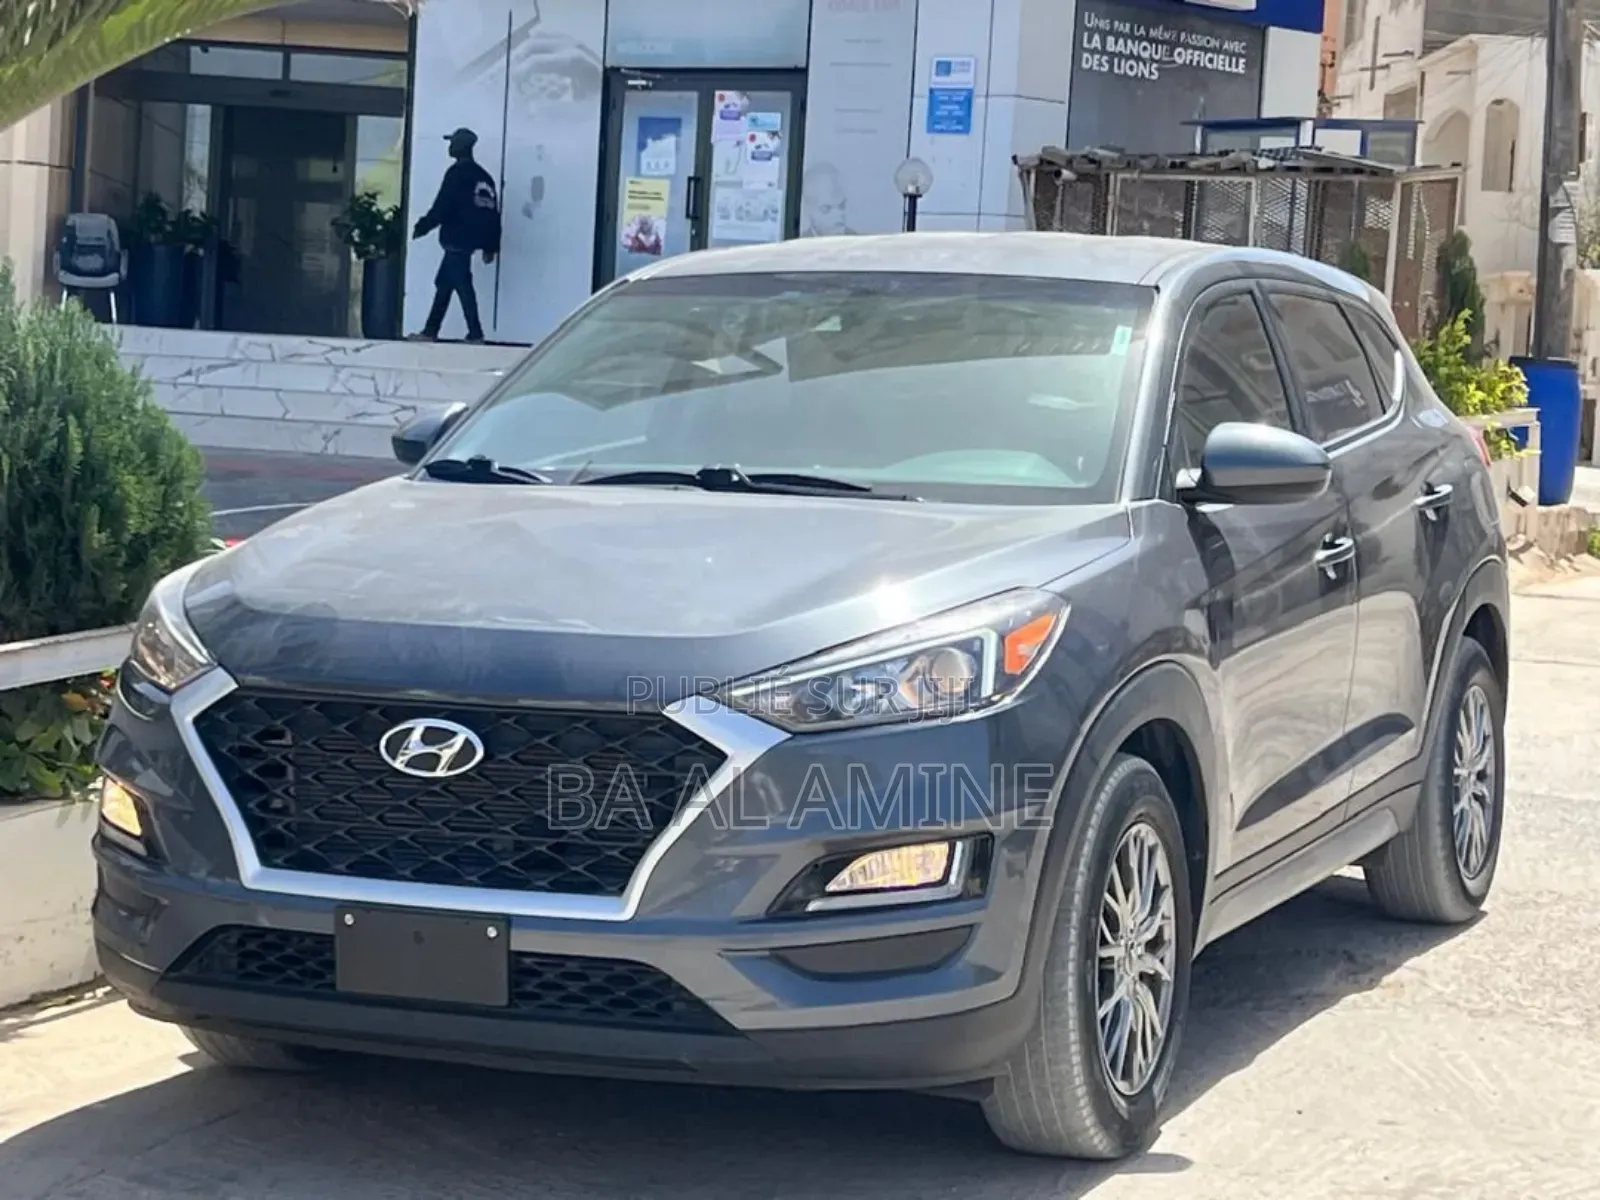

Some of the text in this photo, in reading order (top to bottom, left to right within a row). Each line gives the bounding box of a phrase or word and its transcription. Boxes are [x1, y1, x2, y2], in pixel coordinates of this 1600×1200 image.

[1082, 32, 1102, 51] LA
[1173, 46, 1248, 75] OFFICIELLE
[1113, 20, 1131, 34] PAR
[1134, 23, 1146, 37] LA
[1180, 31, 1221, 49] PASSION
[1222, 40, 1248, 54] AVEC
[1081, 52, 1160, 80] DES LIONS
